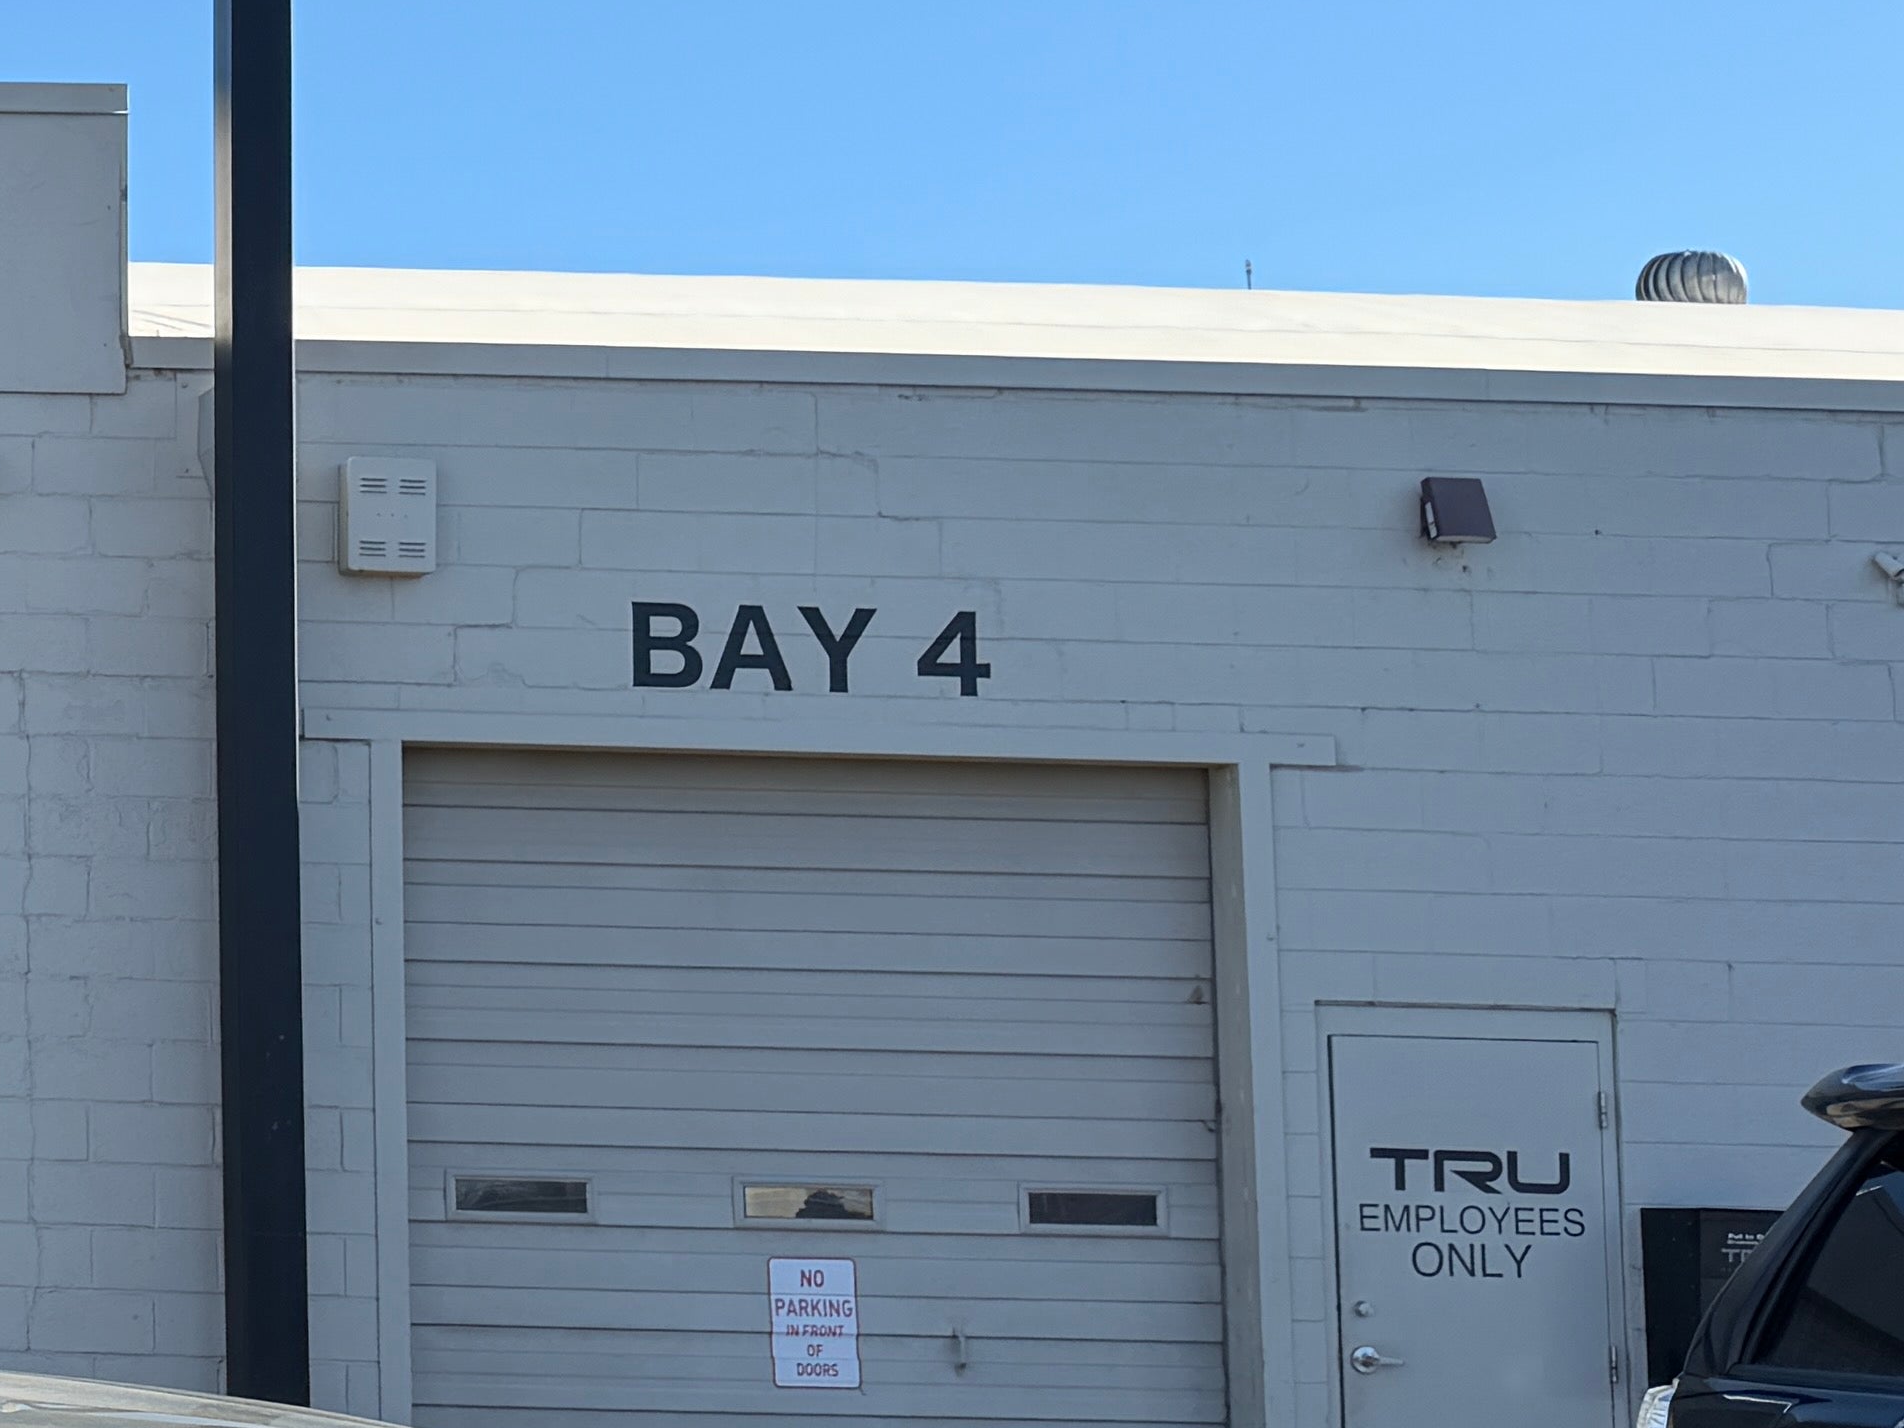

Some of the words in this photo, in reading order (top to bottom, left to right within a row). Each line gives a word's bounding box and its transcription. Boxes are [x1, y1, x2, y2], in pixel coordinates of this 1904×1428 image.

[631, 601, 877, 693] BAY
[917, 611, 991, 697] 4
[1369, 1146, 1571, 1195] TRU
[1358, 1203, 1586, 1237] EMPLOYEES
[1411, 1241, 1533, 1278] ONLY
[800, 1269, 824, 1287] NO
[775, 1298, 853, 1318] PARKING
[786, 1324, 799, 1336] IN
[802, 1324, 844, 1337] FRONT
[807, 1344, 823, 1357] OF
[796, 1363, 839, 1377] DOORS
